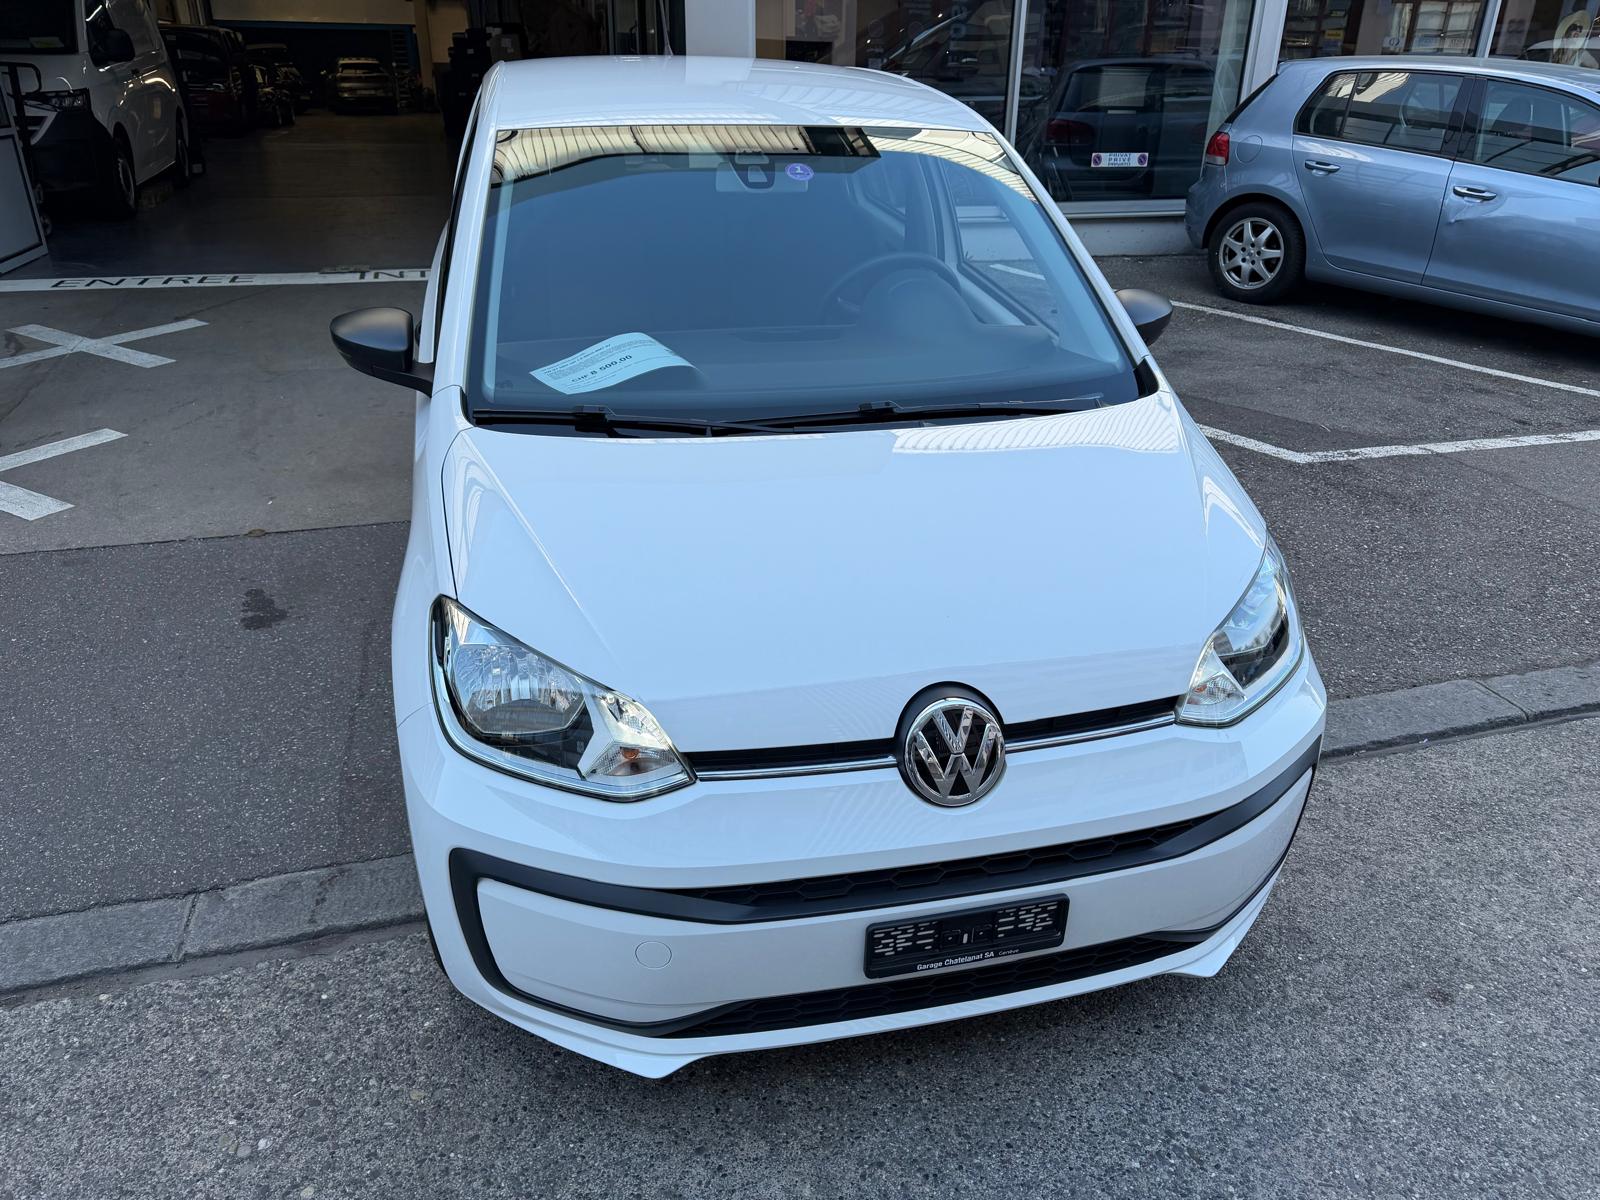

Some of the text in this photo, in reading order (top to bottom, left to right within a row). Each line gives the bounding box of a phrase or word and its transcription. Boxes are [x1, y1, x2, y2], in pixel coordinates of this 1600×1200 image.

[795, 165, 804, 174] 1
[51, 275, 257, 288] ENTREE
[916, 961, 943, 971] Garage
[944, 953, 983, 966] Chatelanat
[984, 951, 995, 959] SA
